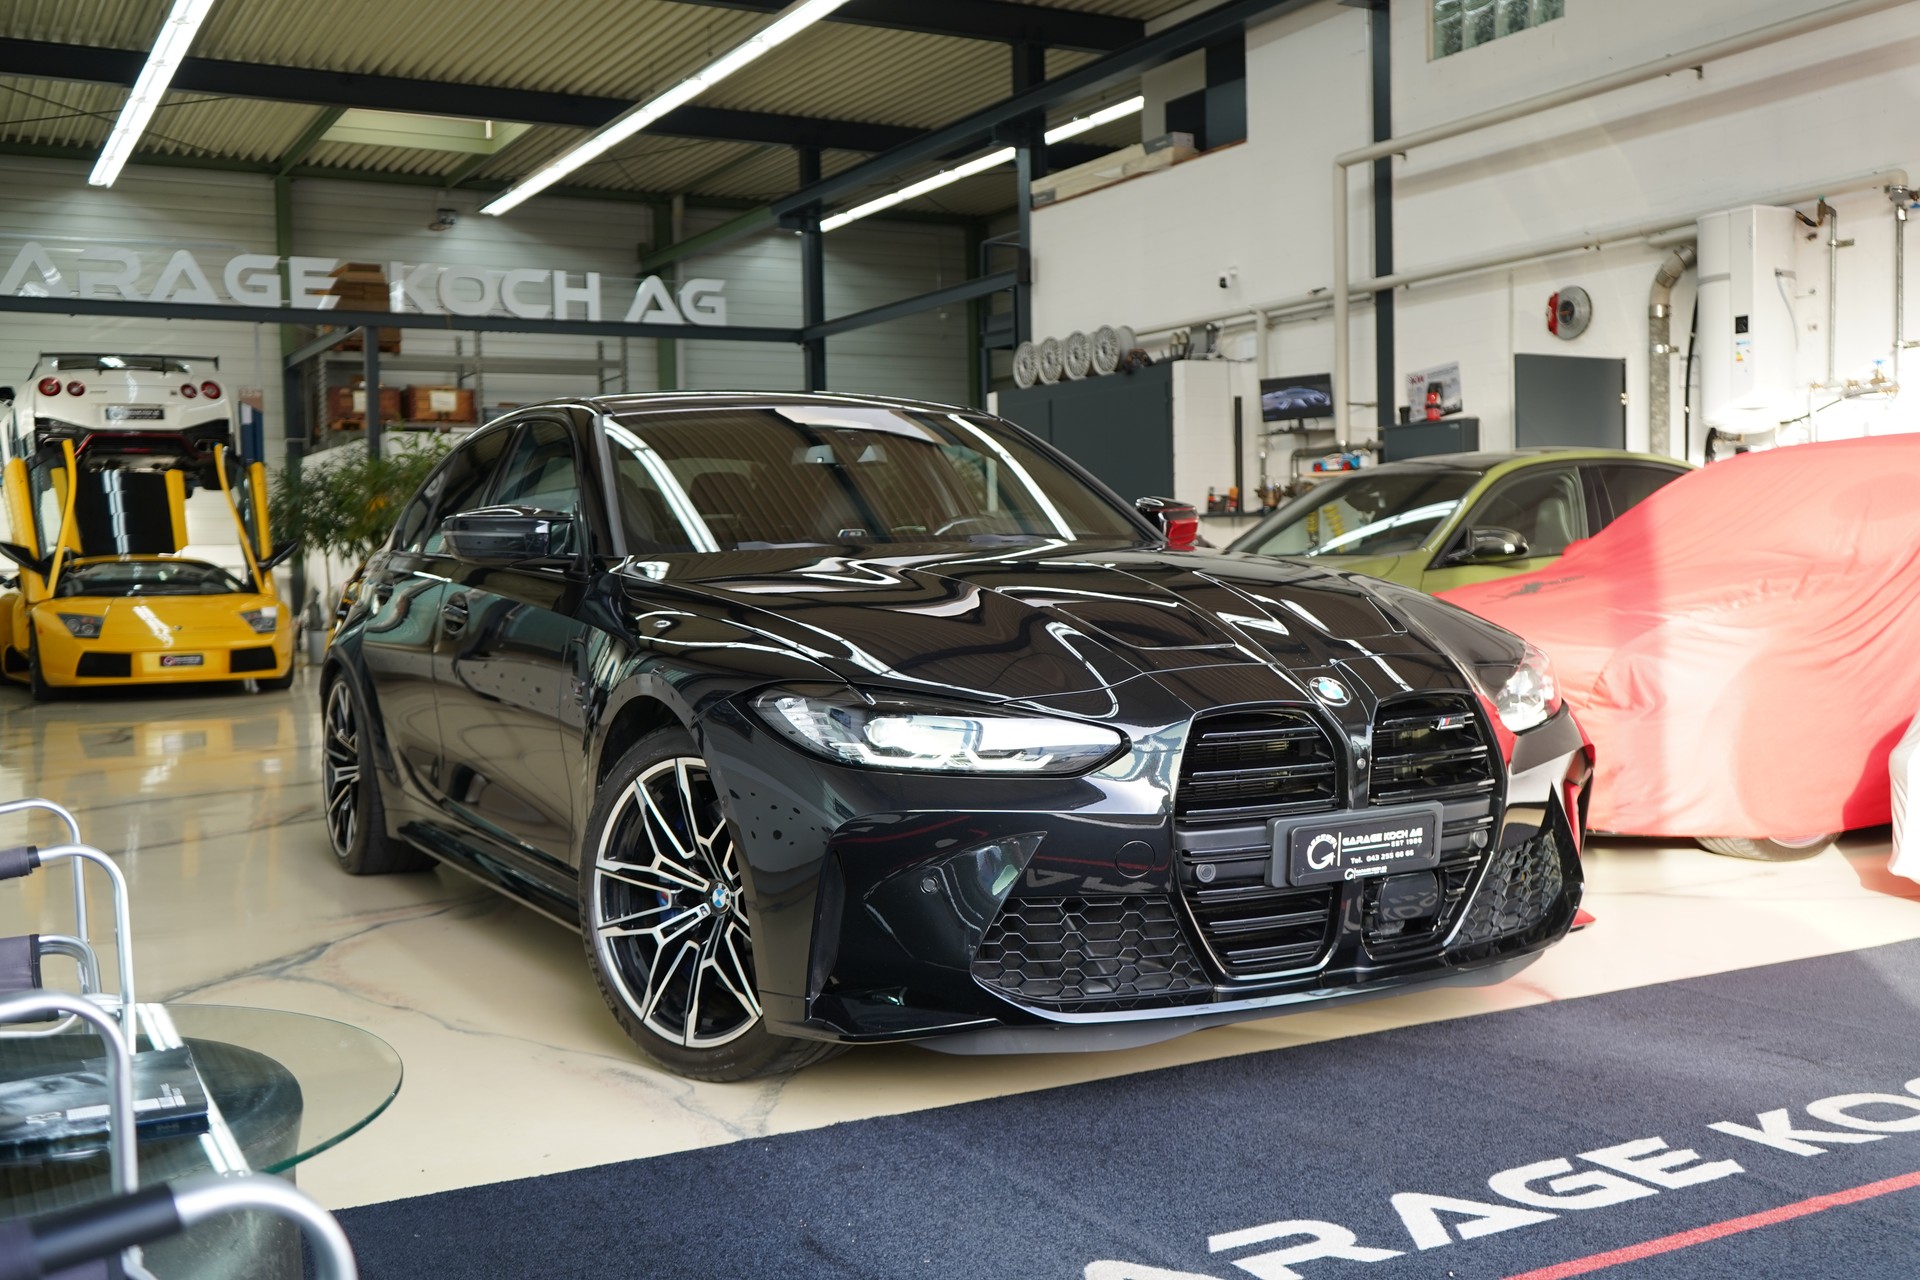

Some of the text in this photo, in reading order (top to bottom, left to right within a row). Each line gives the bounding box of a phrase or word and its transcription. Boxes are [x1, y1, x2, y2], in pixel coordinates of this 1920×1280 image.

[389, 261, 600, 322] KOCH
[624, 275, 727, 326] AG
[1342, 827, 1423, 846] GARAGE KOCH AG
[1350, 857, 1363, 865] Tel.
[1366, 854, 1380, 863] 043
[1706, 1077, 1920, 1157] KO
